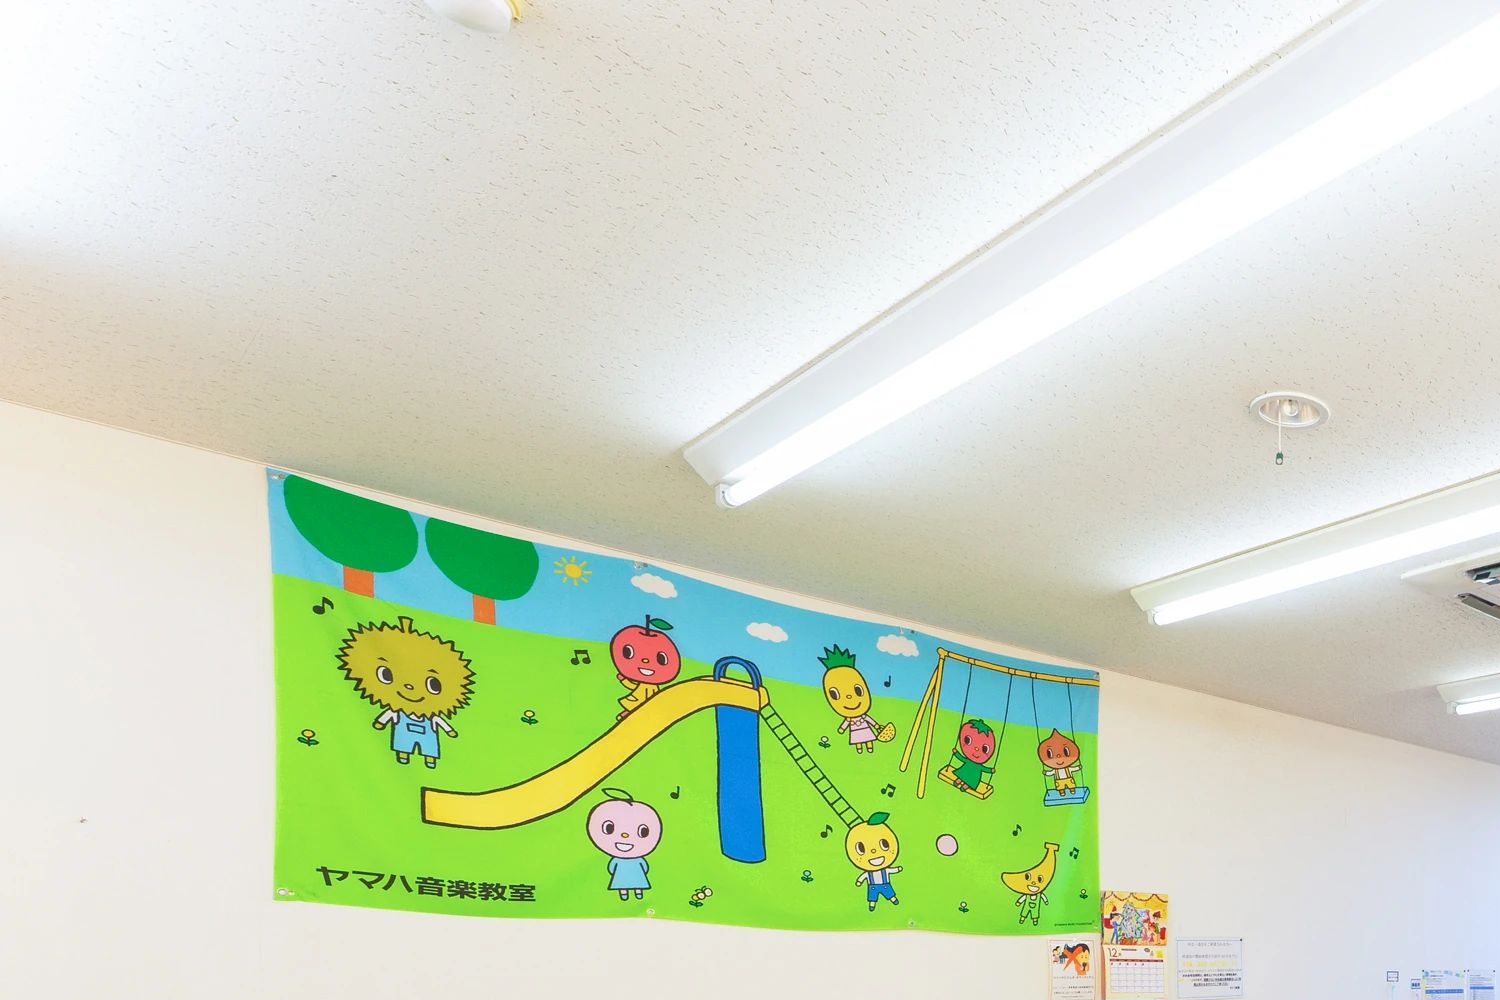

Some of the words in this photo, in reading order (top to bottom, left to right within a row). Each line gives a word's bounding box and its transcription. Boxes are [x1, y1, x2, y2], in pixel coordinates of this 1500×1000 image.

[316, 866, 536, 902] ヤマハ音楽教室
